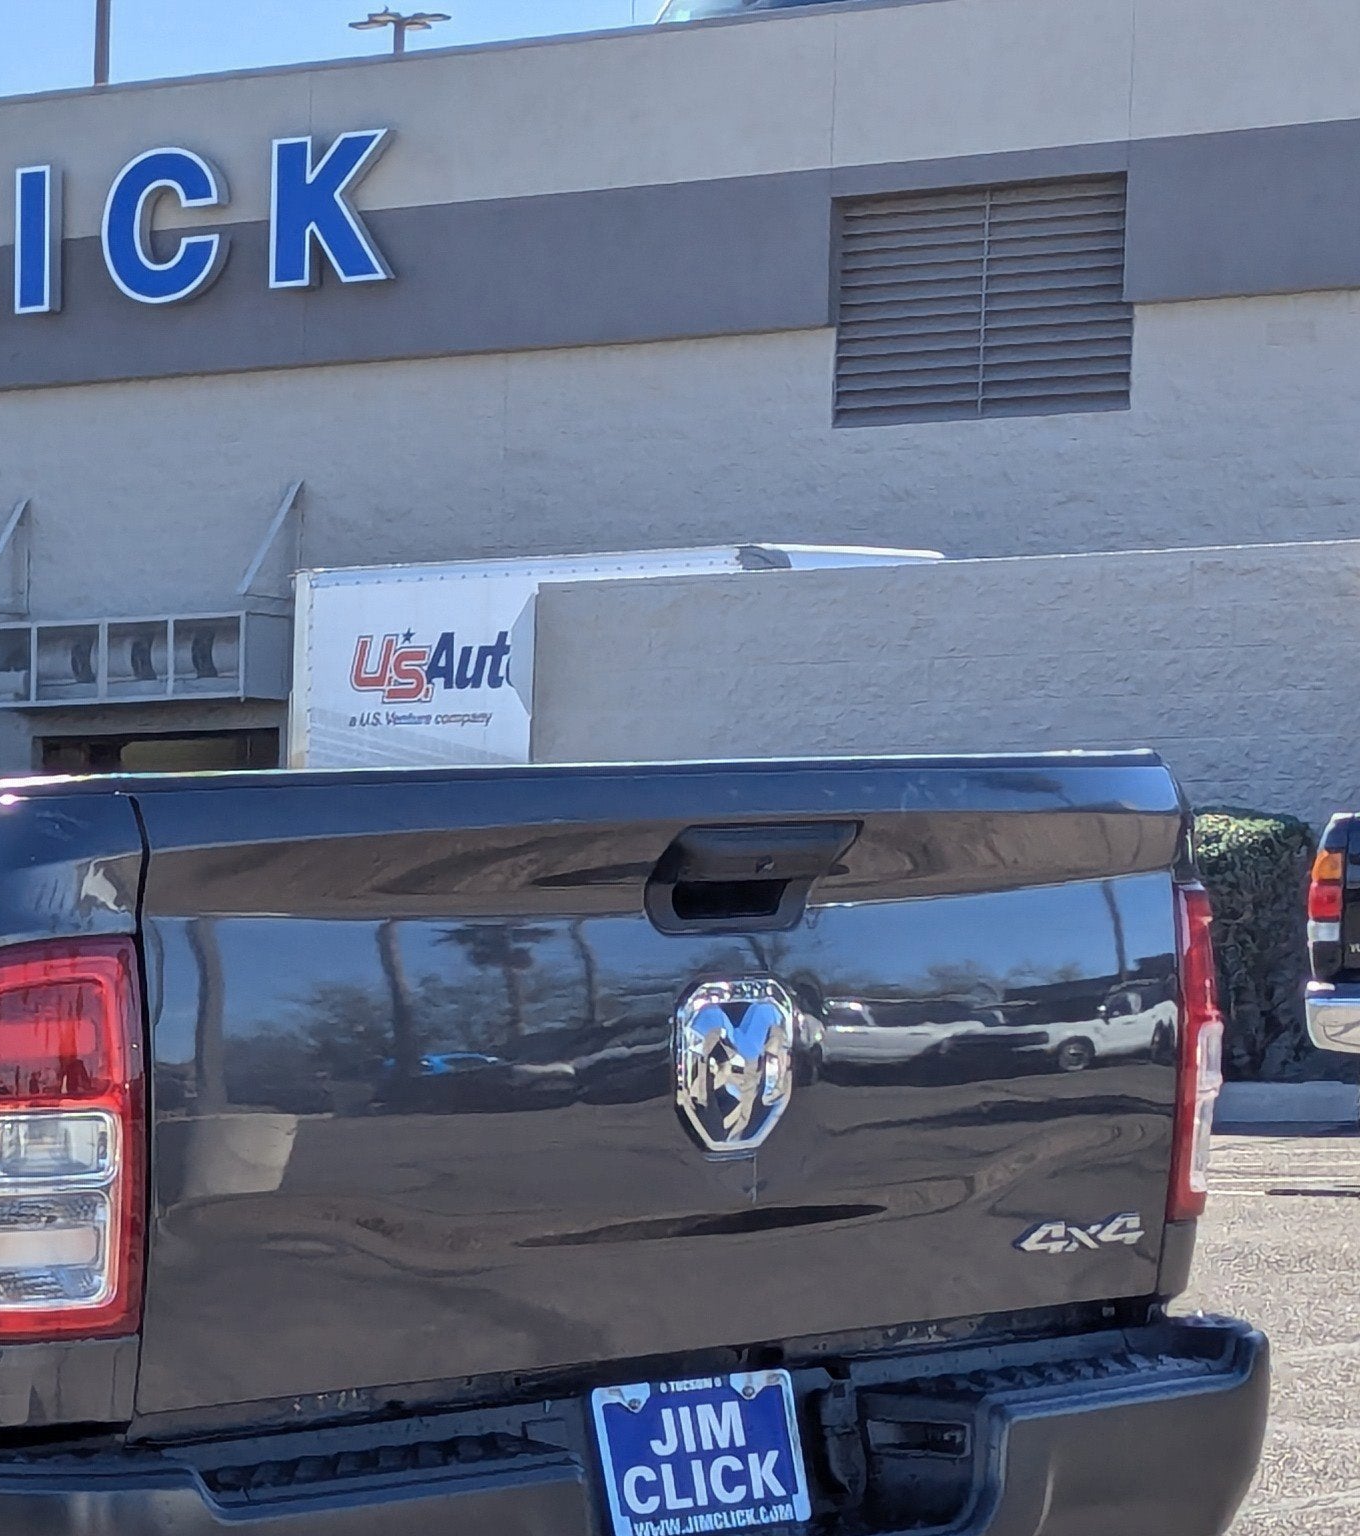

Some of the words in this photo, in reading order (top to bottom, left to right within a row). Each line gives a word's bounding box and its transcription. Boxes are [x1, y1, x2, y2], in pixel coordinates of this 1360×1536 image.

[426, 630, 513, 690] Aut
[649, 1400, 747, 1457] JIM
[623, 1450, 787, 1515] CLICK
